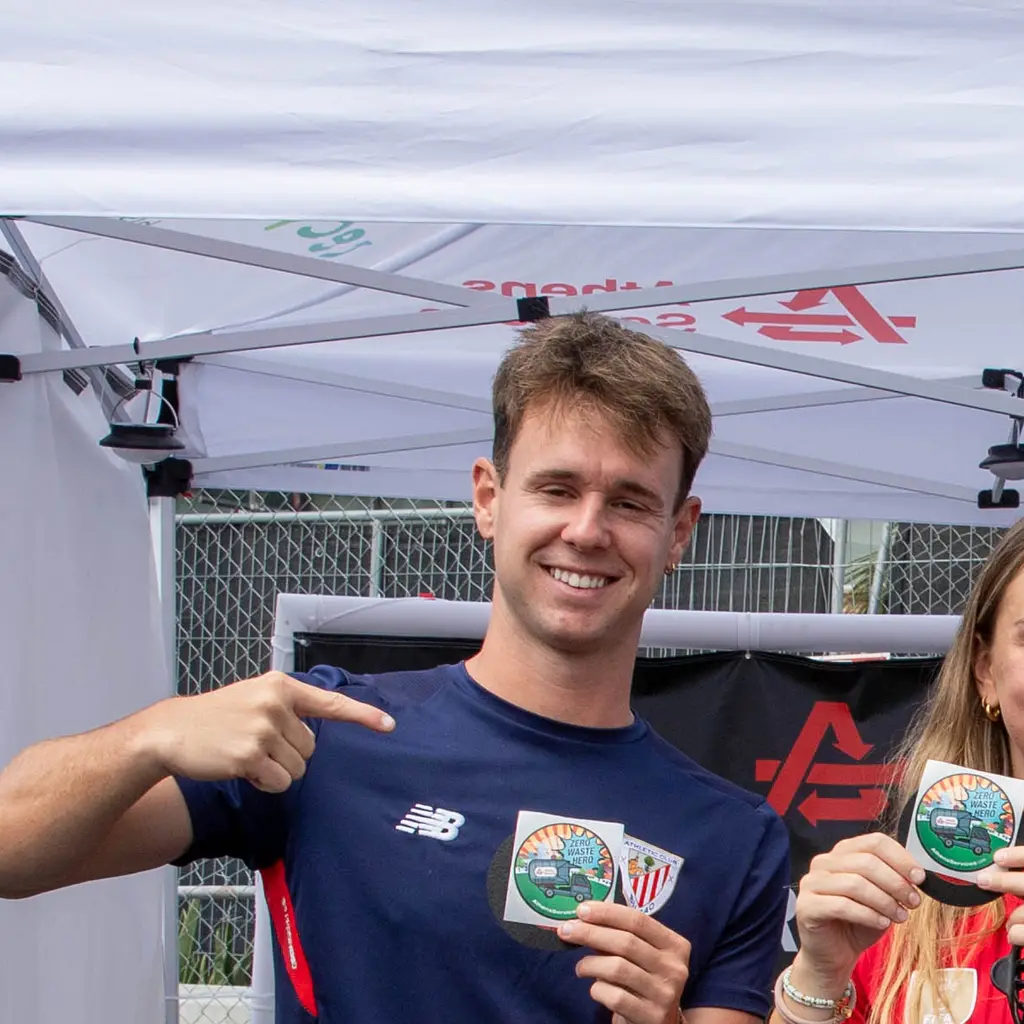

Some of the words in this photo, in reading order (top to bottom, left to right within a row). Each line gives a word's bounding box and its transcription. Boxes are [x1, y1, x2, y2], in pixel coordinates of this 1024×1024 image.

[973, 791, 995, 800] ZERO
[970, 800, 998, 810] WASTE
[974, 809, 996, 818] HERO
[569, 839, 591, 847] ZERO
[567, 847, 595, 857] WASTE
[572, 856, 594, 865] HERO
